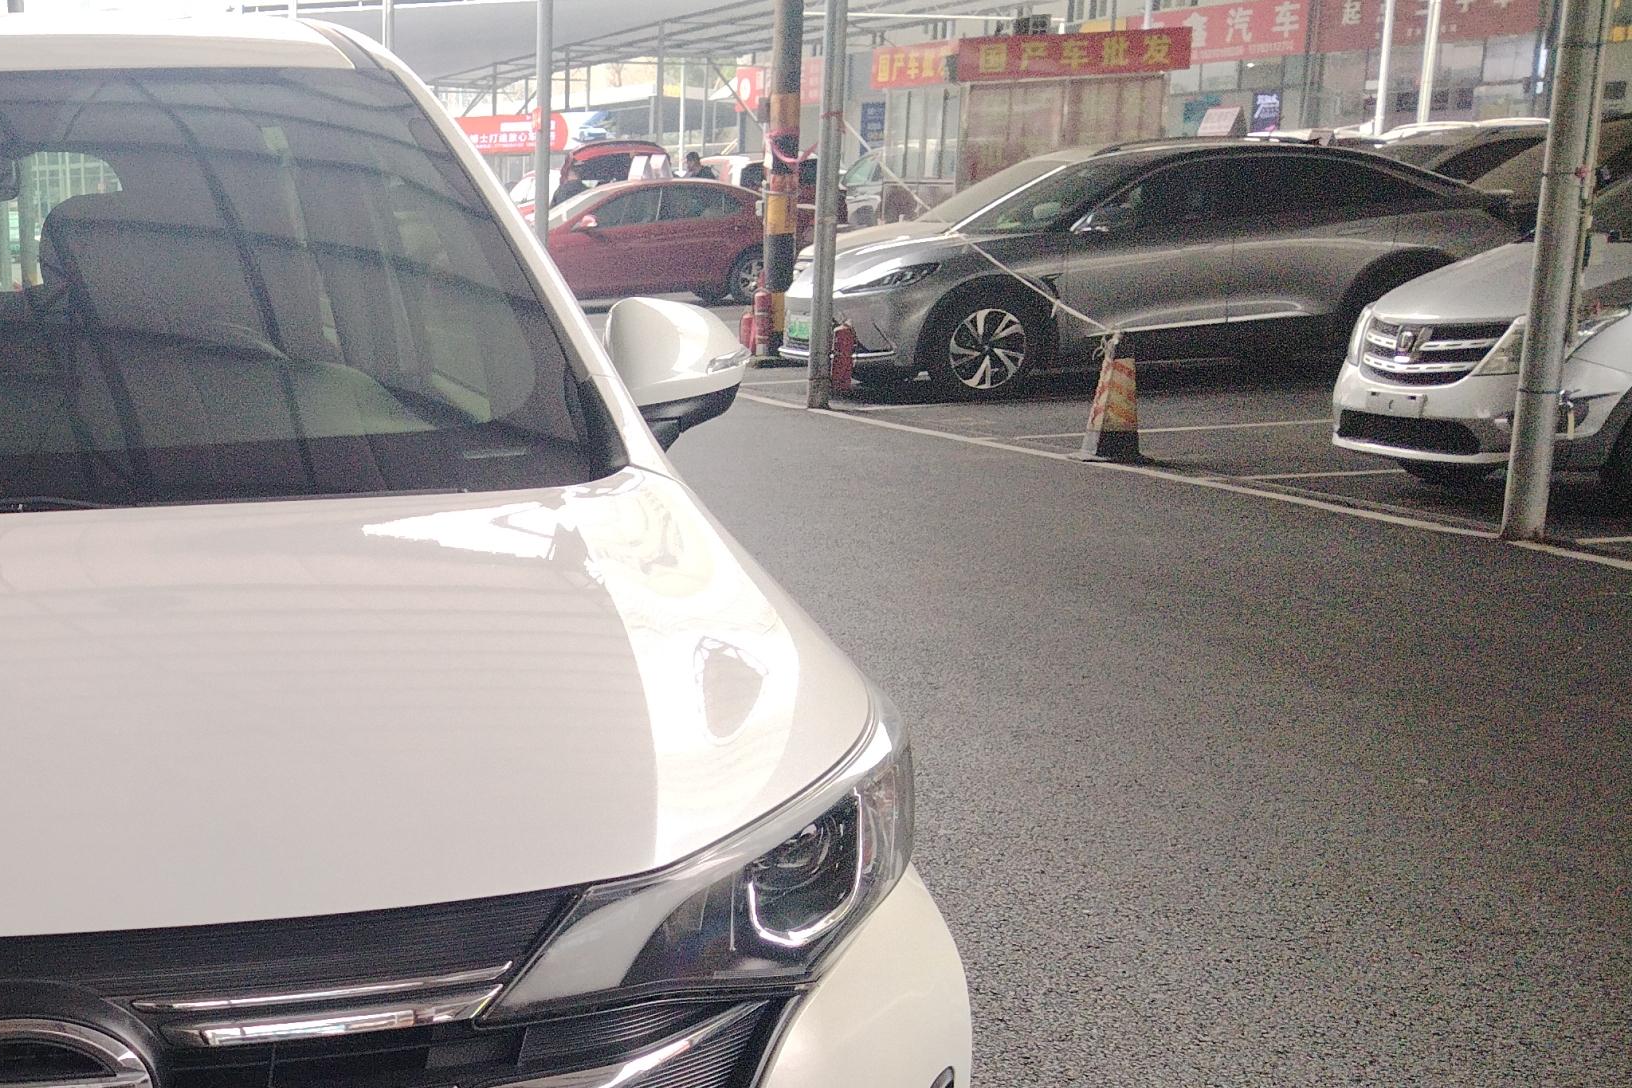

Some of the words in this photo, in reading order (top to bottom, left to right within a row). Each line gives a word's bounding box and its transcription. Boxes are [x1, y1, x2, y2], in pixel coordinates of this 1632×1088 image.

[978, 35, 1173, 73] 国产车批发
